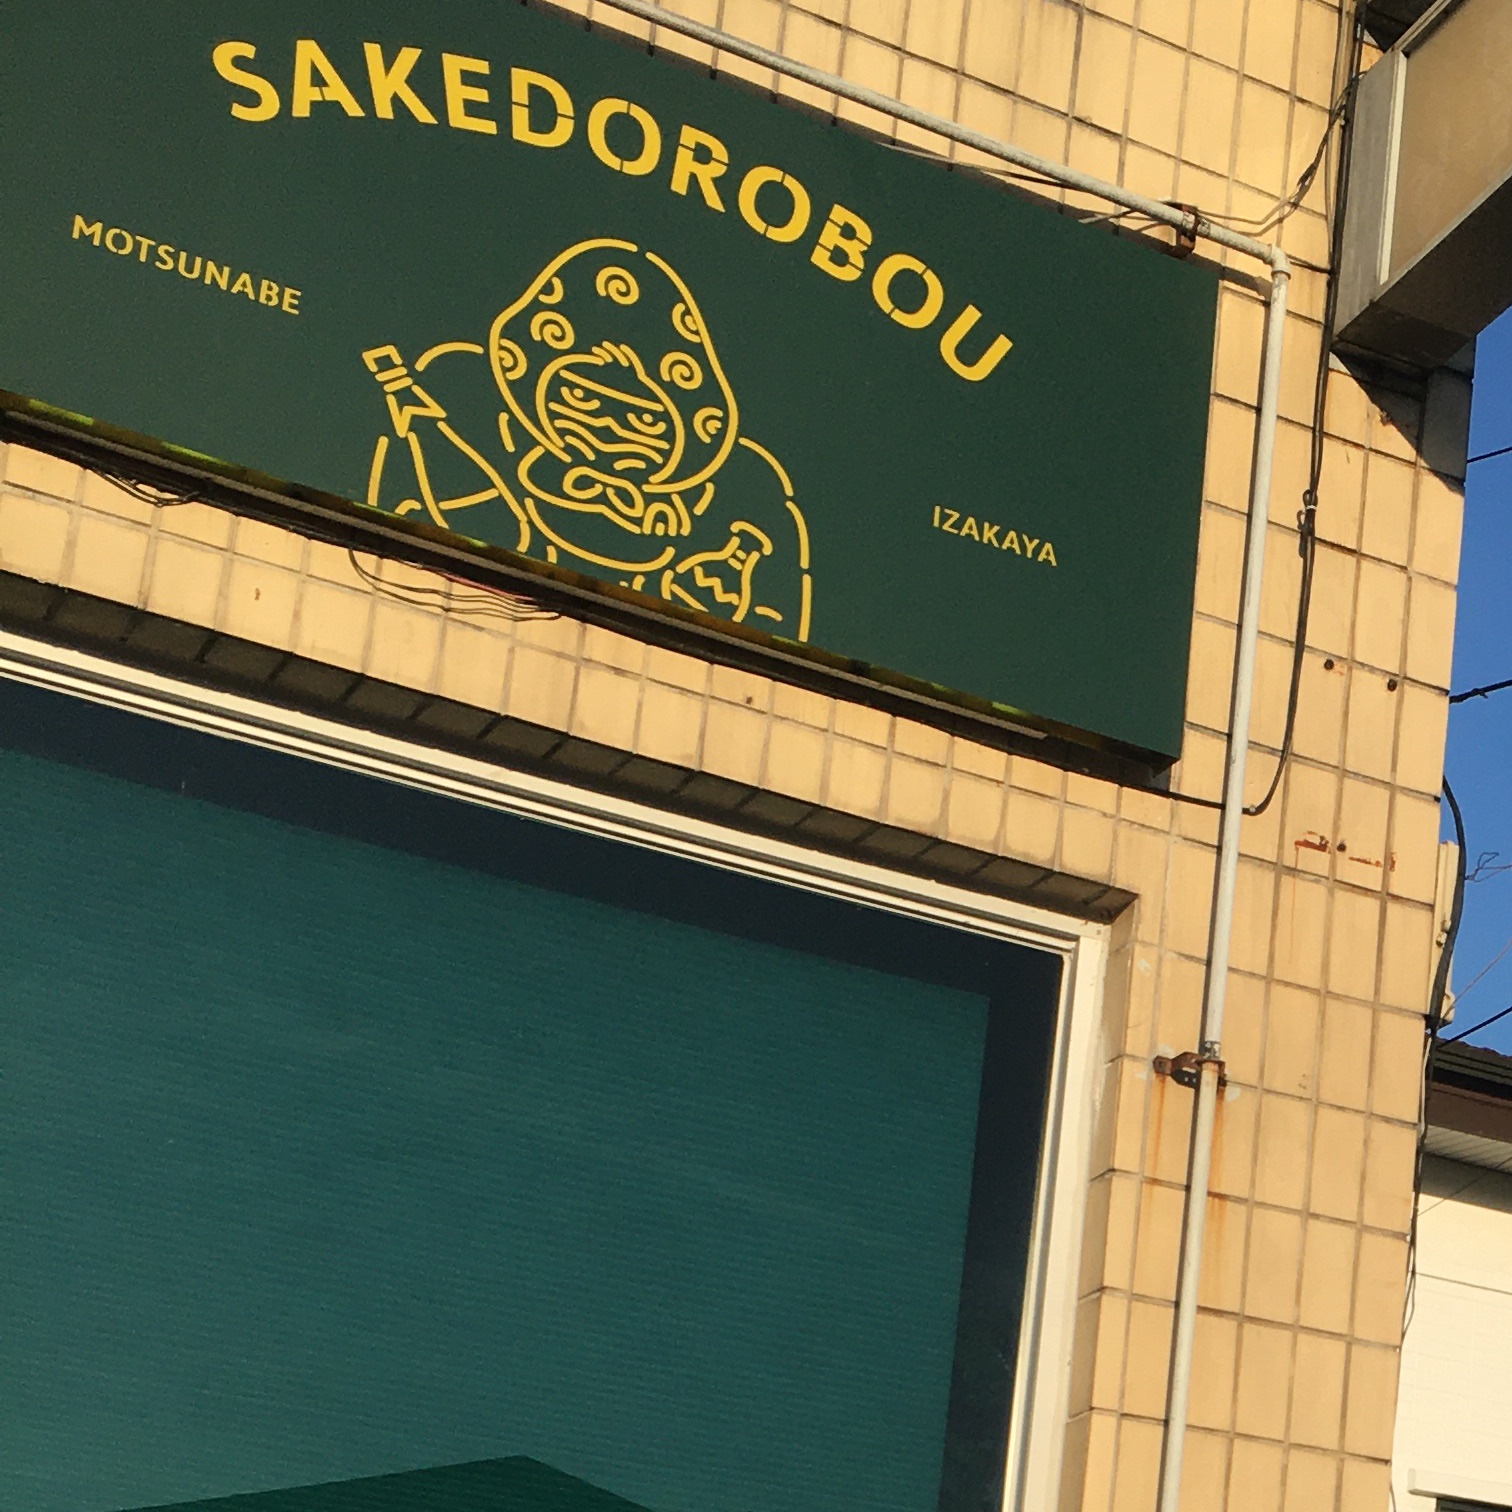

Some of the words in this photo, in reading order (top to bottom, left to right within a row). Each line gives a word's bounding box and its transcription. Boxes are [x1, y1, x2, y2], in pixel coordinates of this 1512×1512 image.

[212, 39, 1014, 382] SAKEDOROBOU
[72, 214, 302, 315] MOTSUNABE
[932, 504, 1058, 567] IZAKAYA
